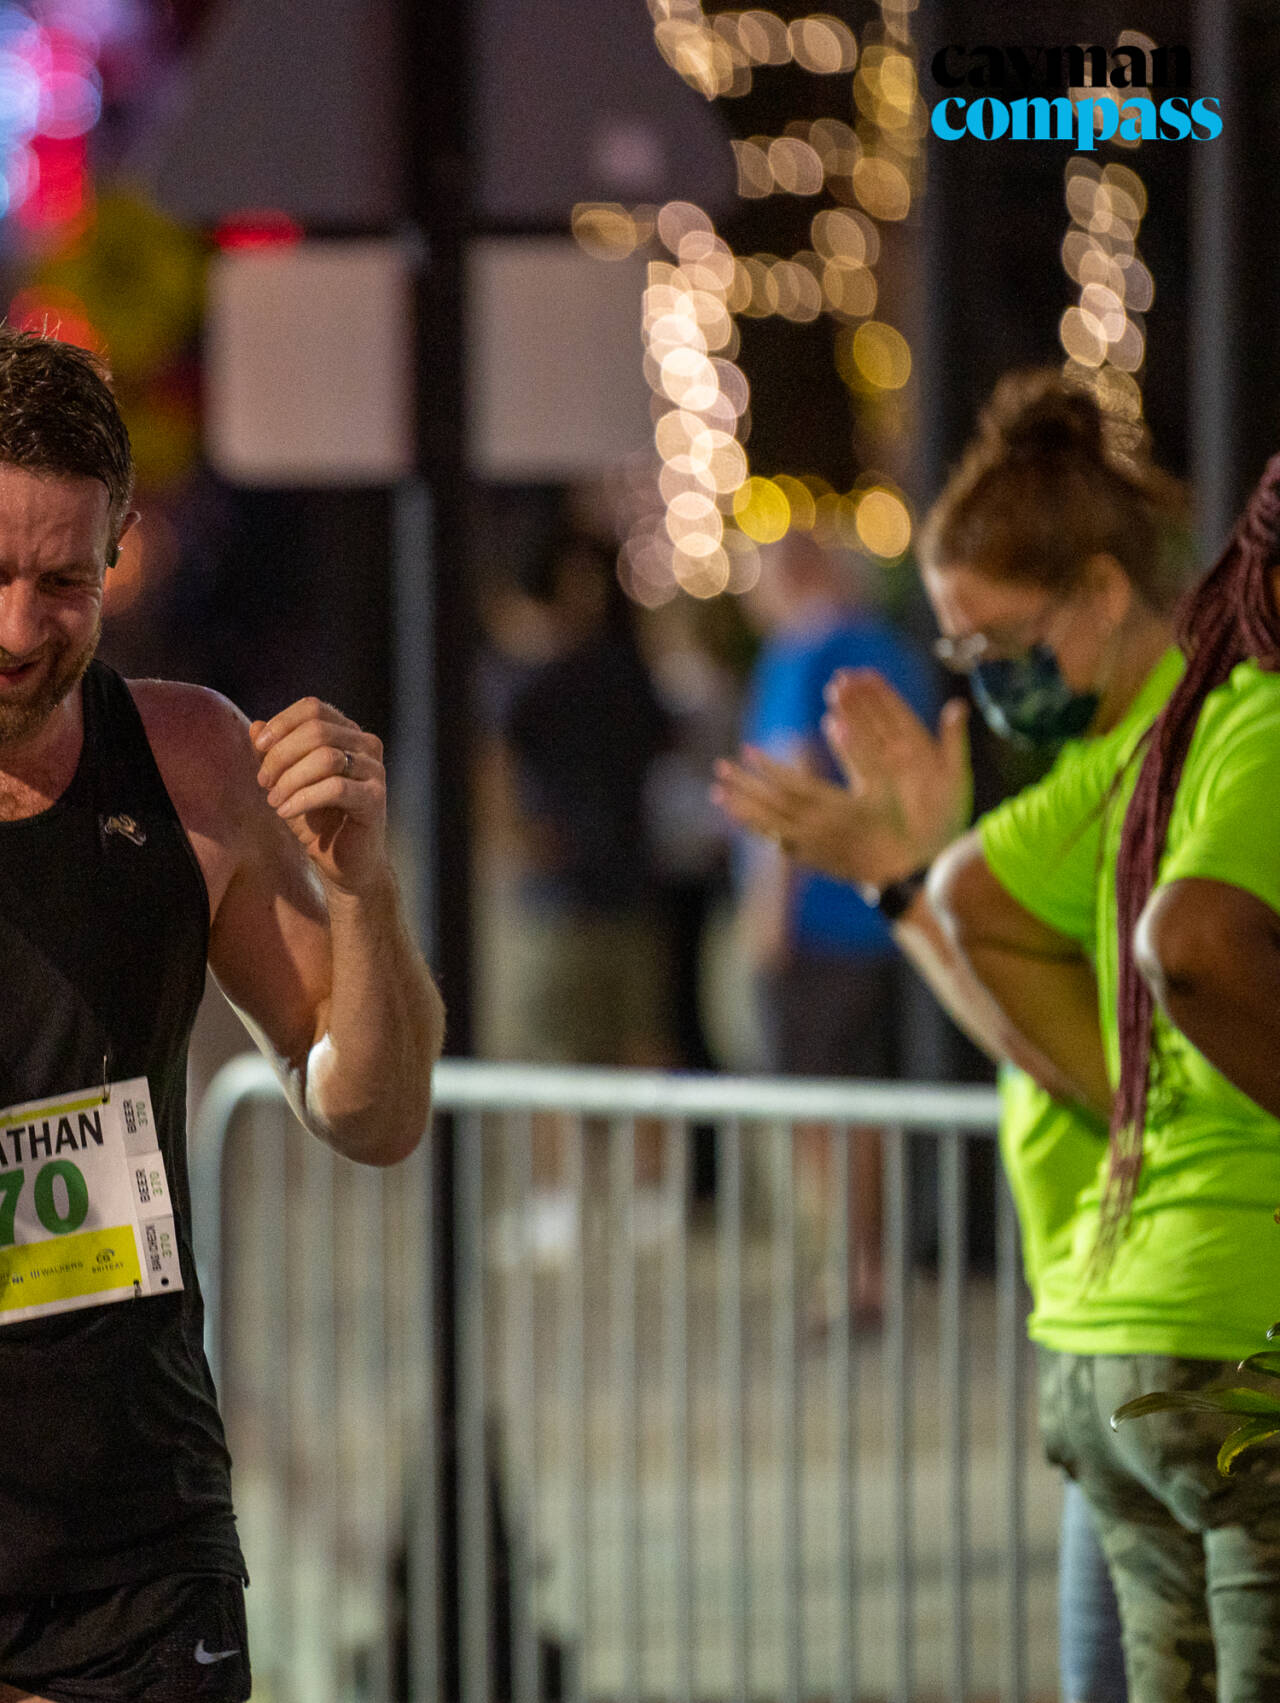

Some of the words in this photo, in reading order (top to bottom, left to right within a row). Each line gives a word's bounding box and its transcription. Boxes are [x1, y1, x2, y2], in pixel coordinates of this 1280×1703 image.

[123, 1100, 136, 1133] BEER
[136, 1102, 148, 1126] 370
[136, 1169, 150, 1203] BEER
[150, 1171, 163, 1196] 370
[160, 1233, 172, 1258] 370
